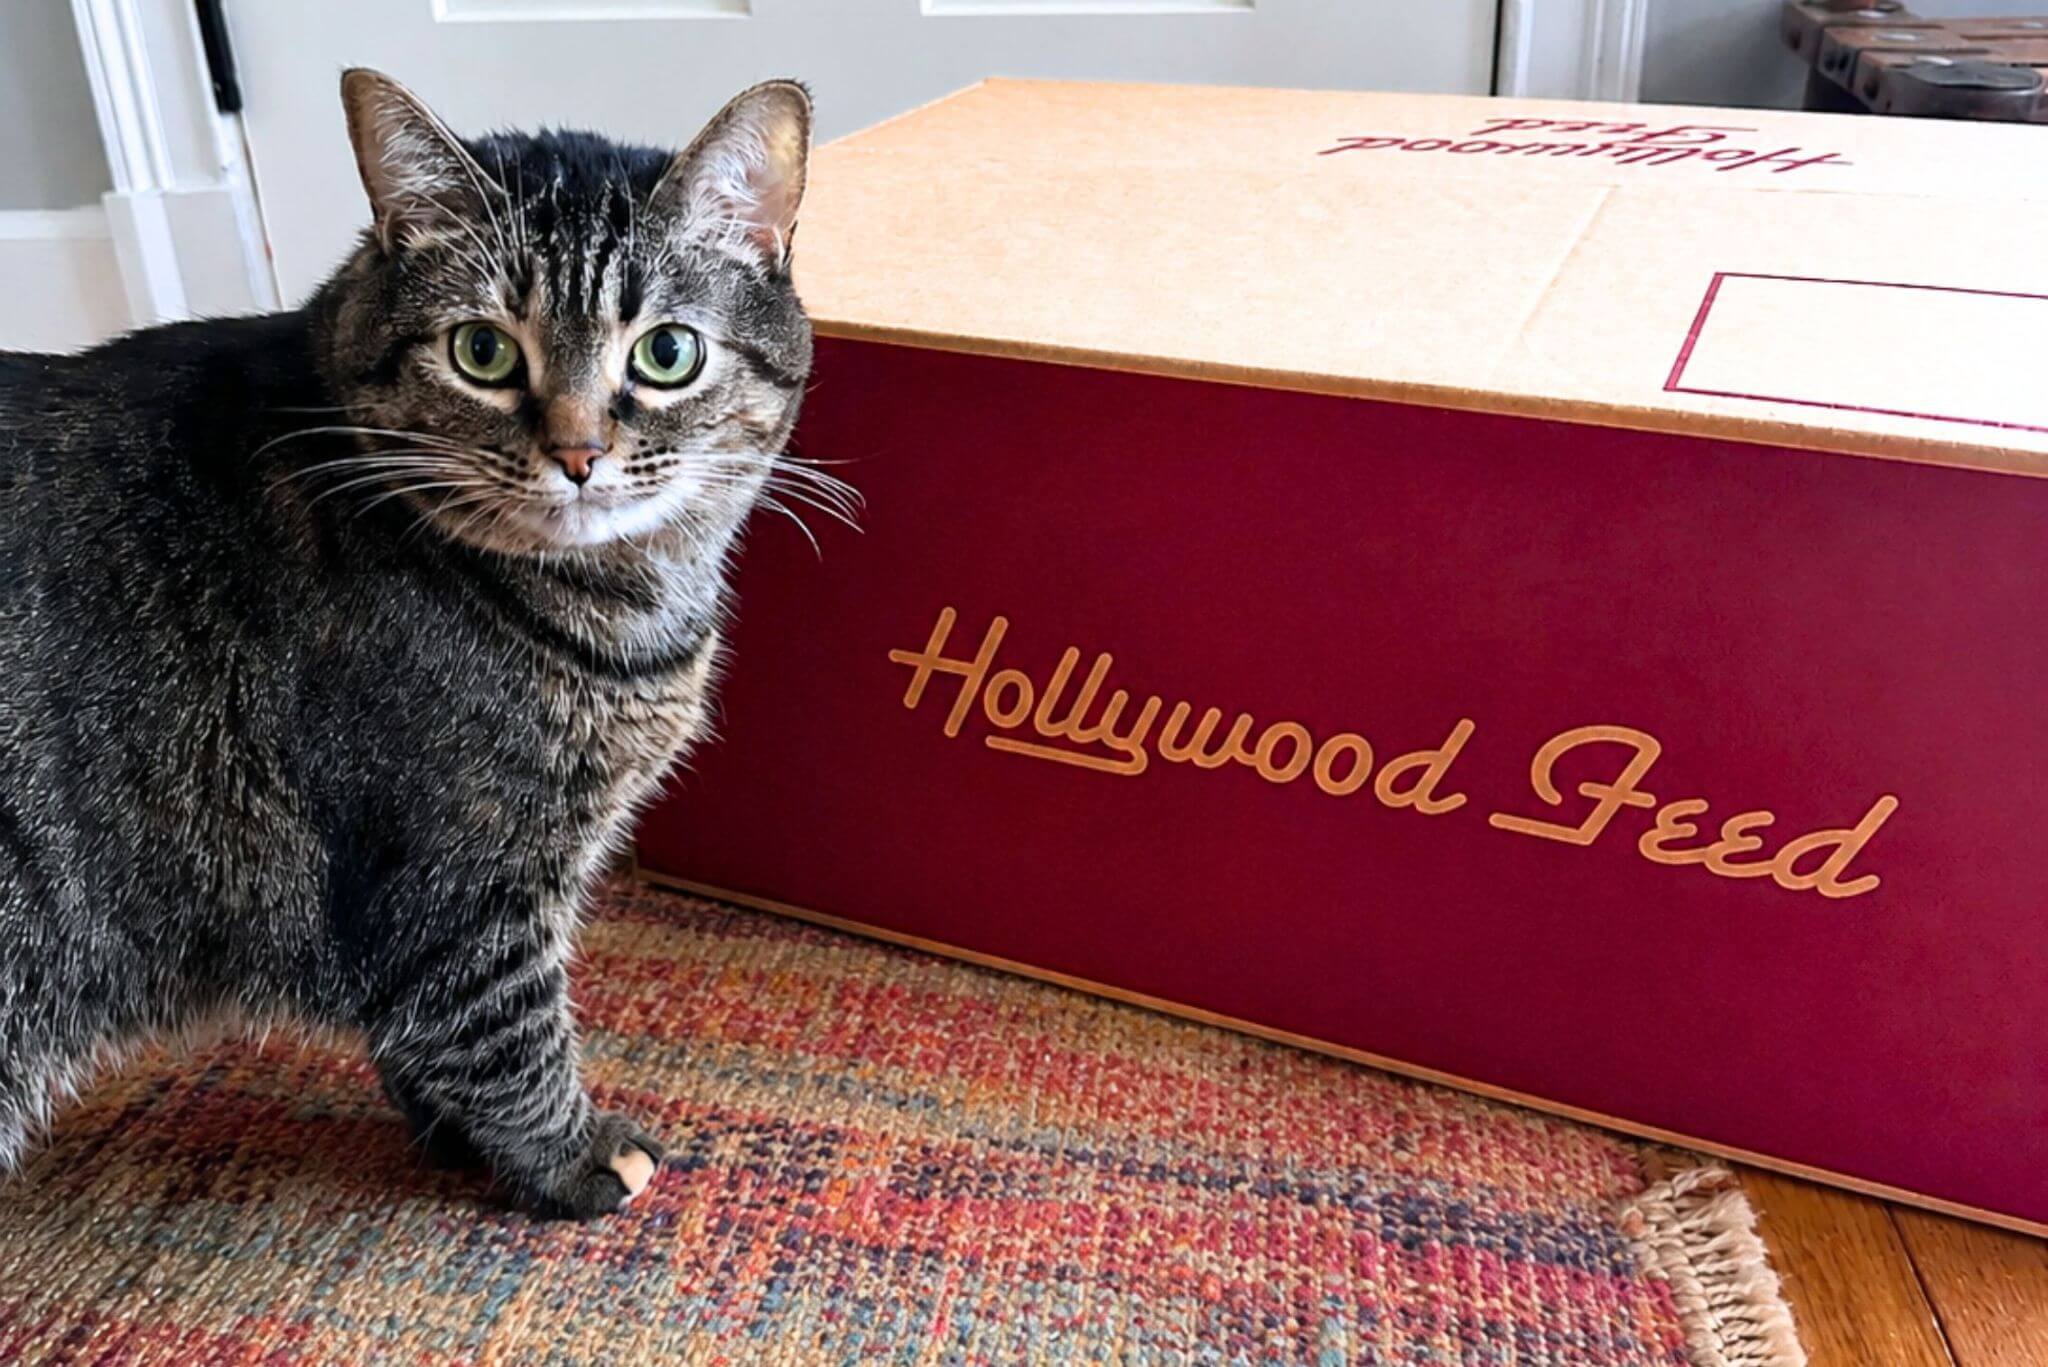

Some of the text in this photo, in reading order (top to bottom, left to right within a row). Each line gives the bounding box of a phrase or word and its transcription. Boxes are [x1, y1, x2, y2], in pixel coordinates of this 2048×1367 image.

[1471, 118, 1758, 144] Feed
[1319, 136, 1854, 173] Hollywood
[888, 606, 1899, 898] Hollywood Feed
